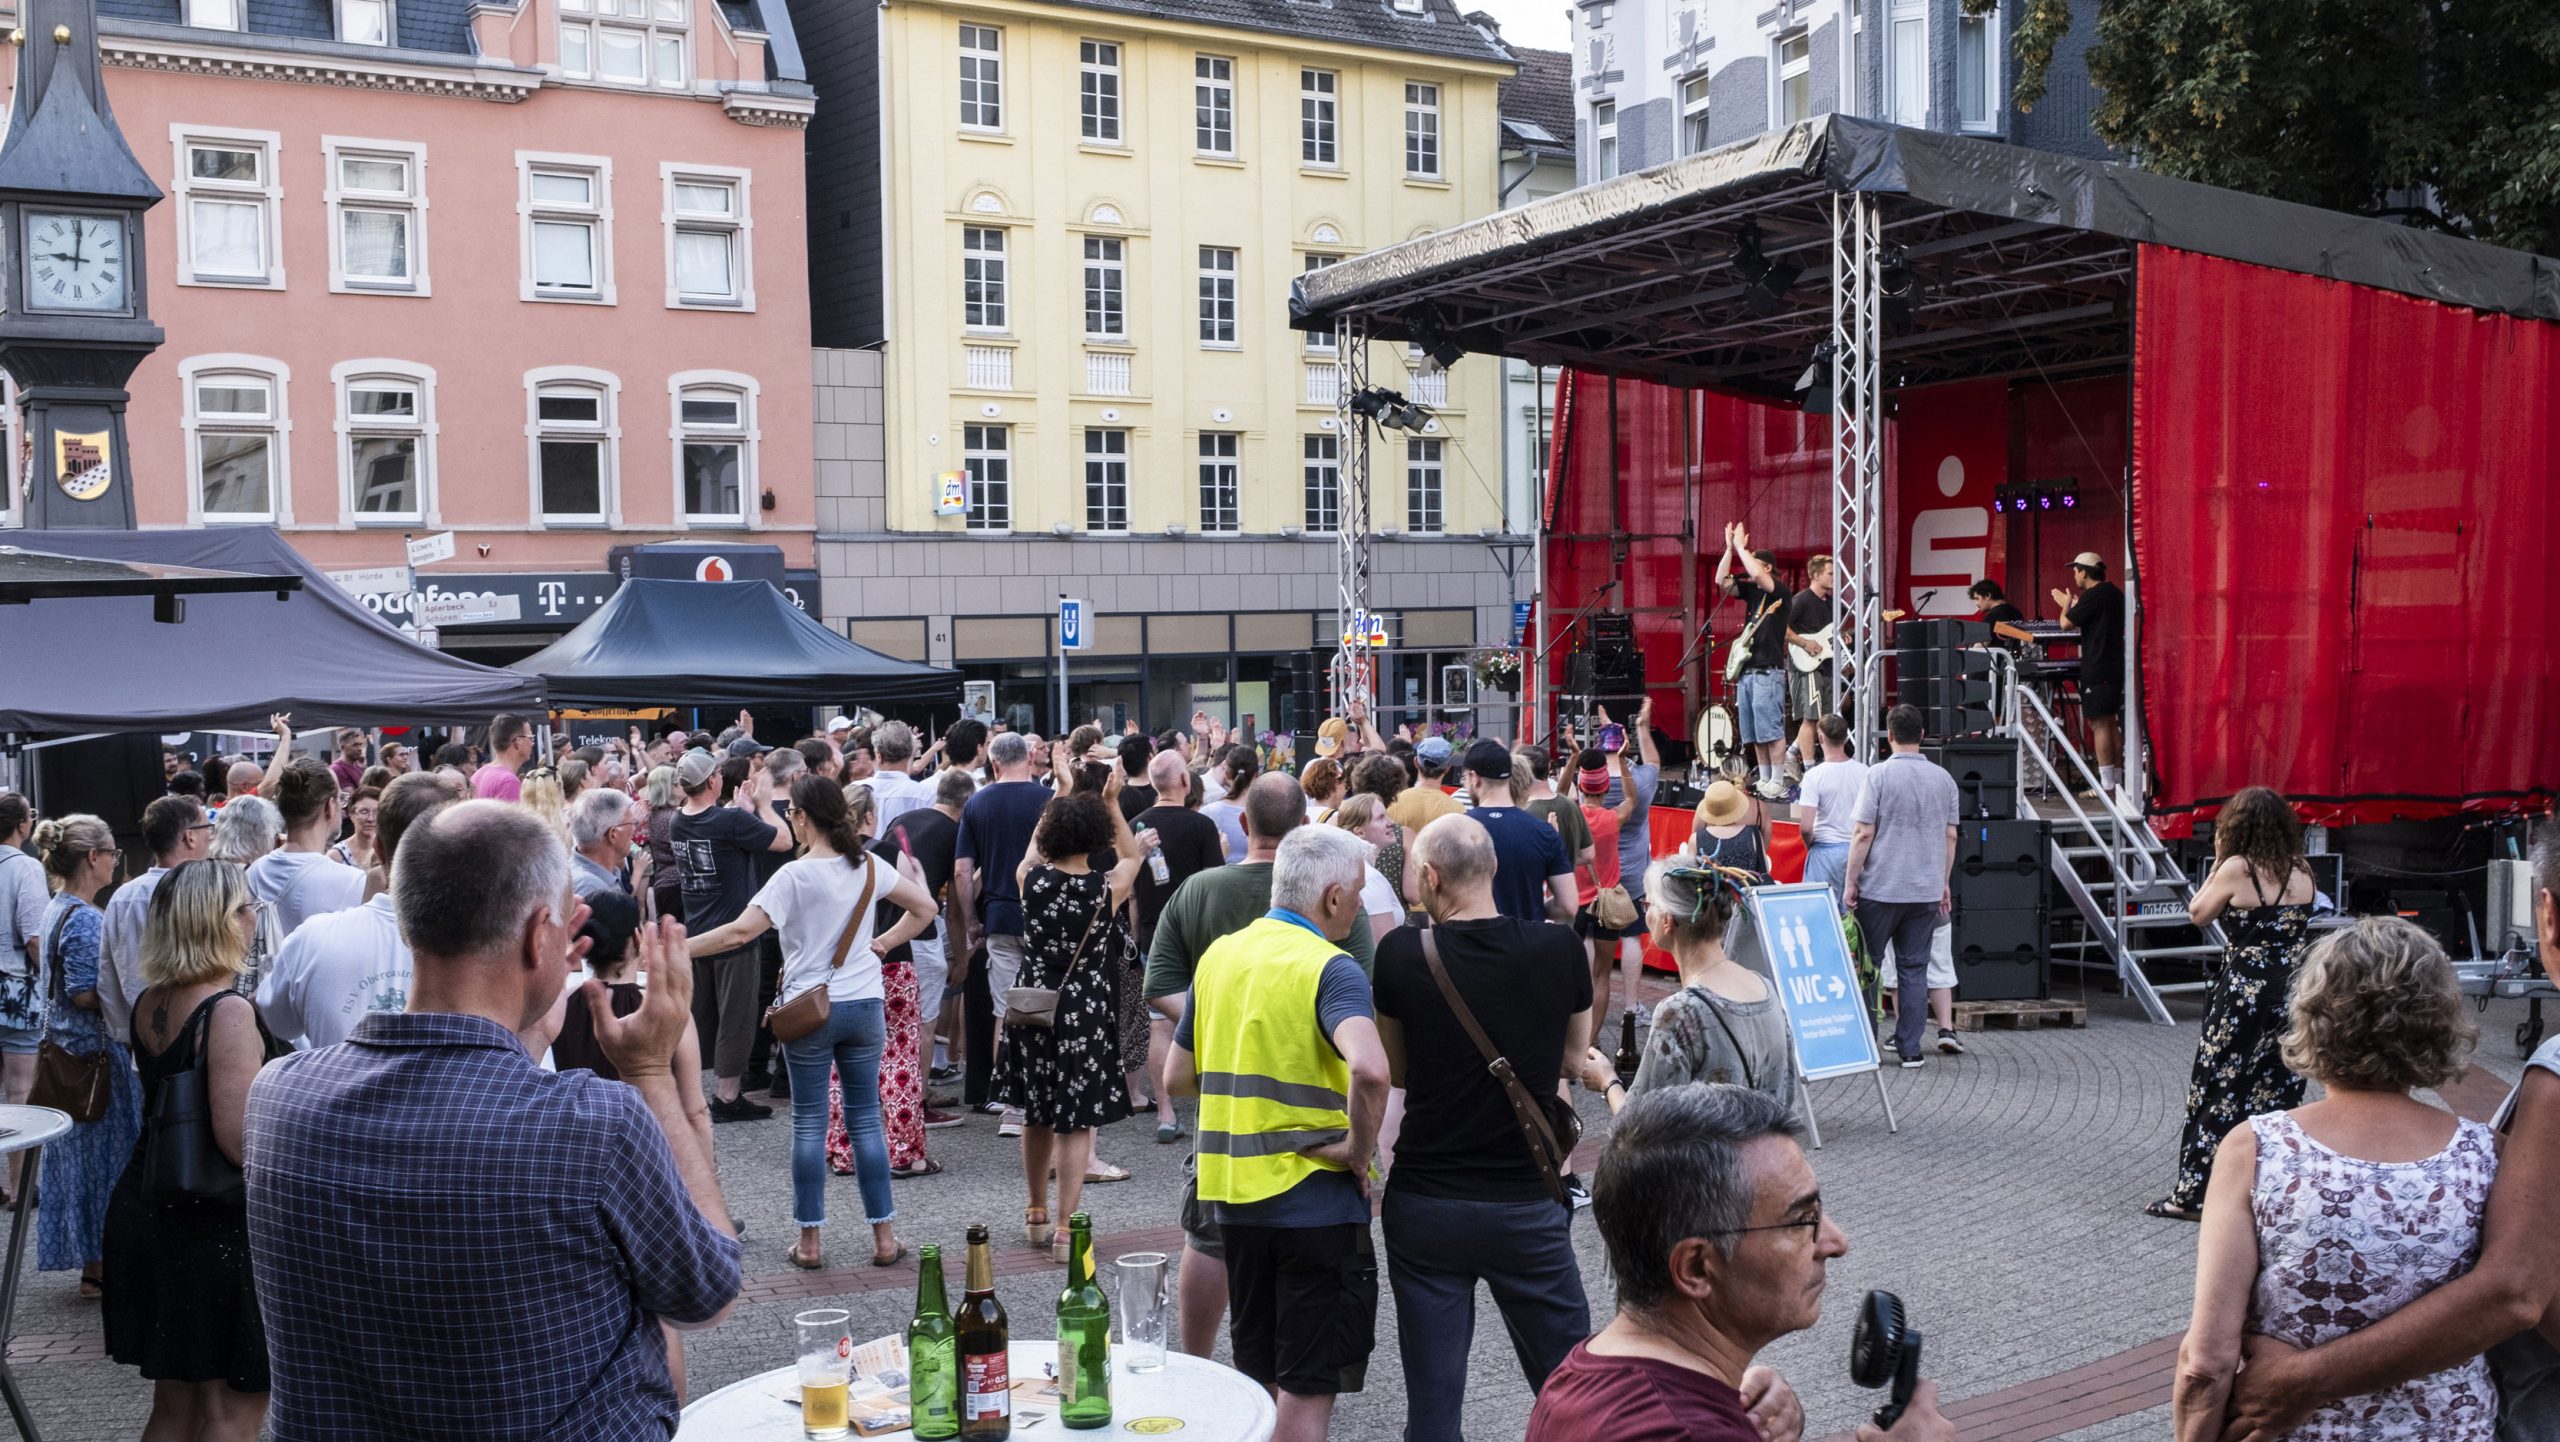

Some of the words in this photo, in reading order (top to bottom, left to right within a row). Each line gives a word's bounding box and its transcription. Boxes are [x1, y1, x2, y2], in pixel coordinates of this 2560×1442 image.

[945, 479, 960, 496] dm
[359, 572, 384, 580] Hörde
[425, 602, 465, 614] Aplerbeck
[425, 613, 458, 623] Schüren
[935, 633, 947, 643] 41
[1193, 694, 1230, 703] Abholstation
[1789, 974, 1827, 1005] WC
